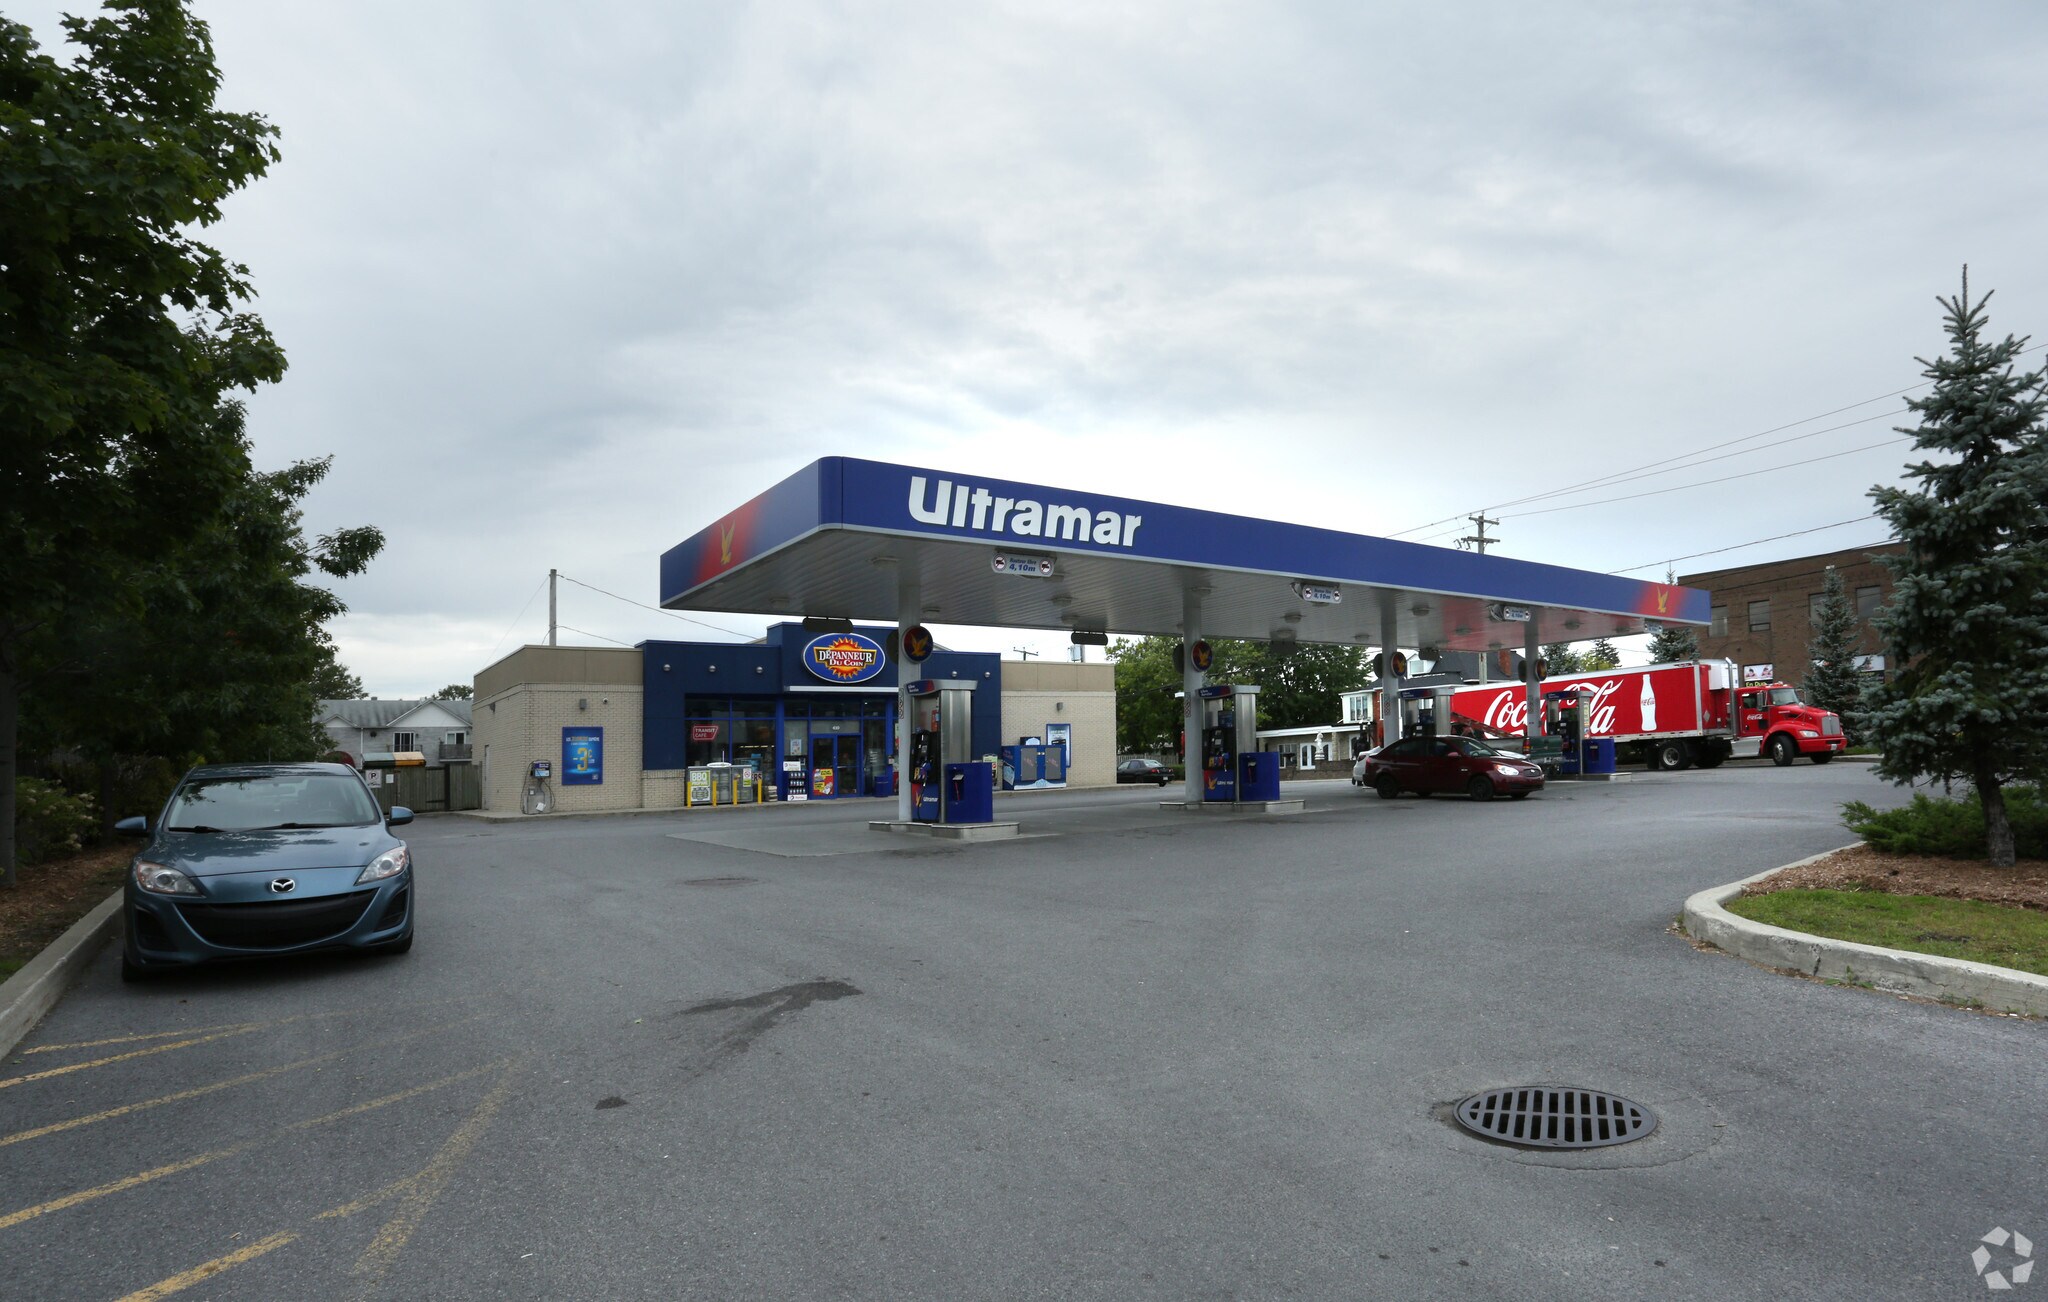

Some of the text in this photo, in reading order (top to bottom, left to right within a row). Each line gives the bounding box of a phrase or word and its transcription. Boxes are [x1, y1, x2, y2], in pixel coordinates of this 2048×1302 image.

[908, 475, 1142, 547] Ultramar
[1009, 563, 1036, 572] 4,10m
[691, 772, 707, 781] BBQ
